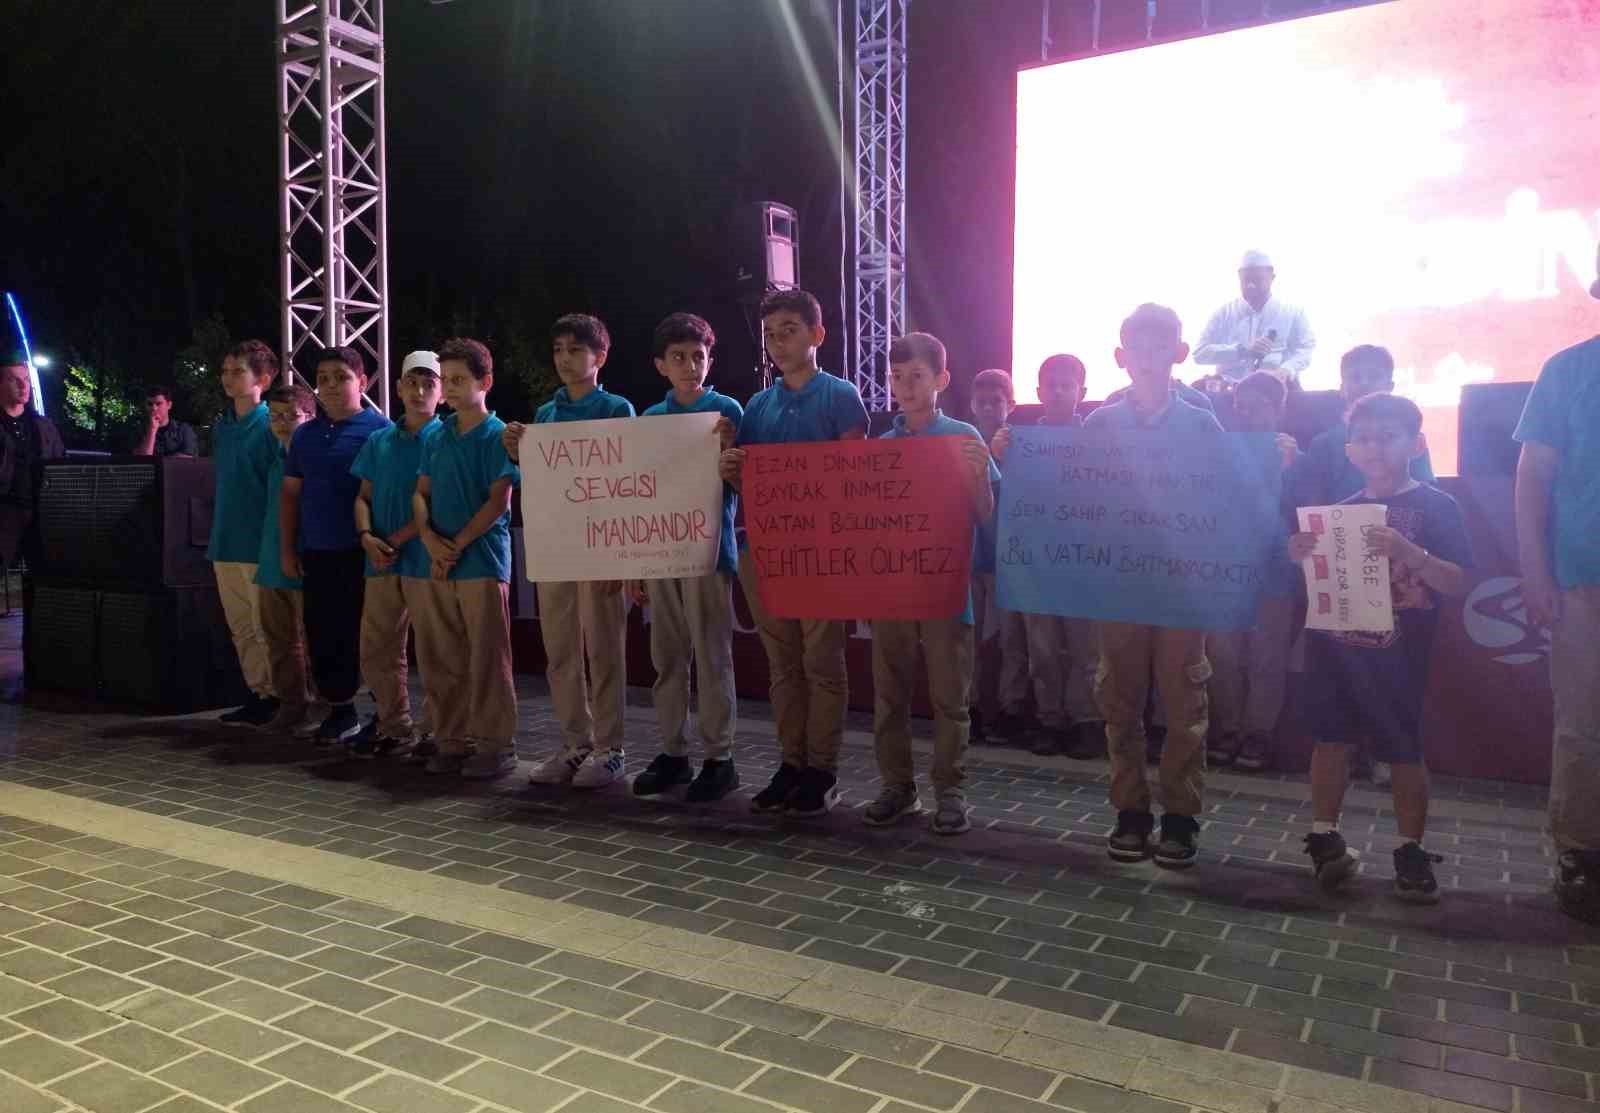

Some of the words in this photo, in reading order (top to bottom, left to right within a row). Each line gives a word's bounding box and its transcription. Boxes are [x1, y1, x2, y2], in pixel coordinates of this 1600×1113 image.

[538, 437, 623, 470] VATAN
[755, 455, 807, 474] EZAN
[755, 480, 826, 506] BAYRAK
[586, 509, 712, 548] İMANDANDIR
[755, 513, 815, 534] VATAN
[1044, 542, 1112, 567] VATAN
[1336, 567, 1350, 591] ZOR
